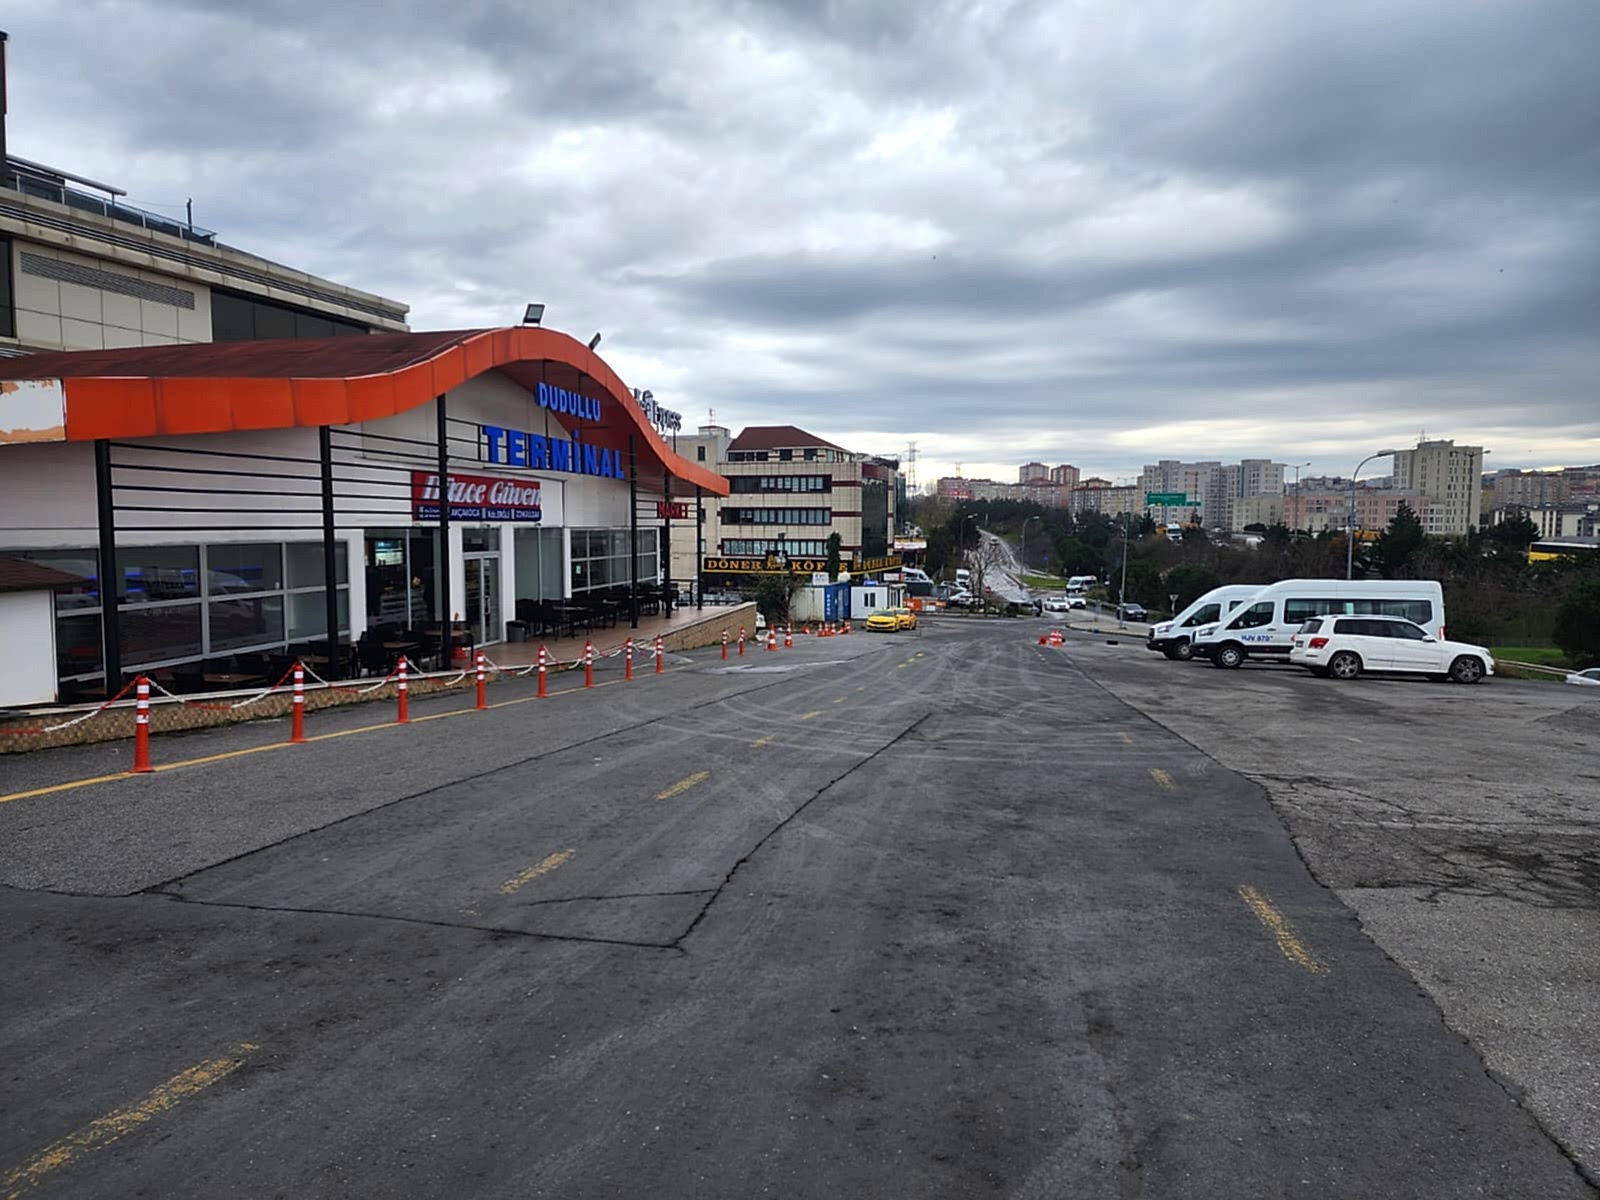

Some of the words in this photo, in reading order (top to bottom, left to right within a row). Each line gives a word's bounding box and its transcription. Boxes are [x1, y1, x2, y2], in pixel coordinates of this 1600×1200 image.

[536, 382, 601, 422] DUDULLU
[482, 424, 625, 480] TERMİNAL
[707, 557, 761, 570] DÖNER
[791, 559, 848, 572] KÖFE
